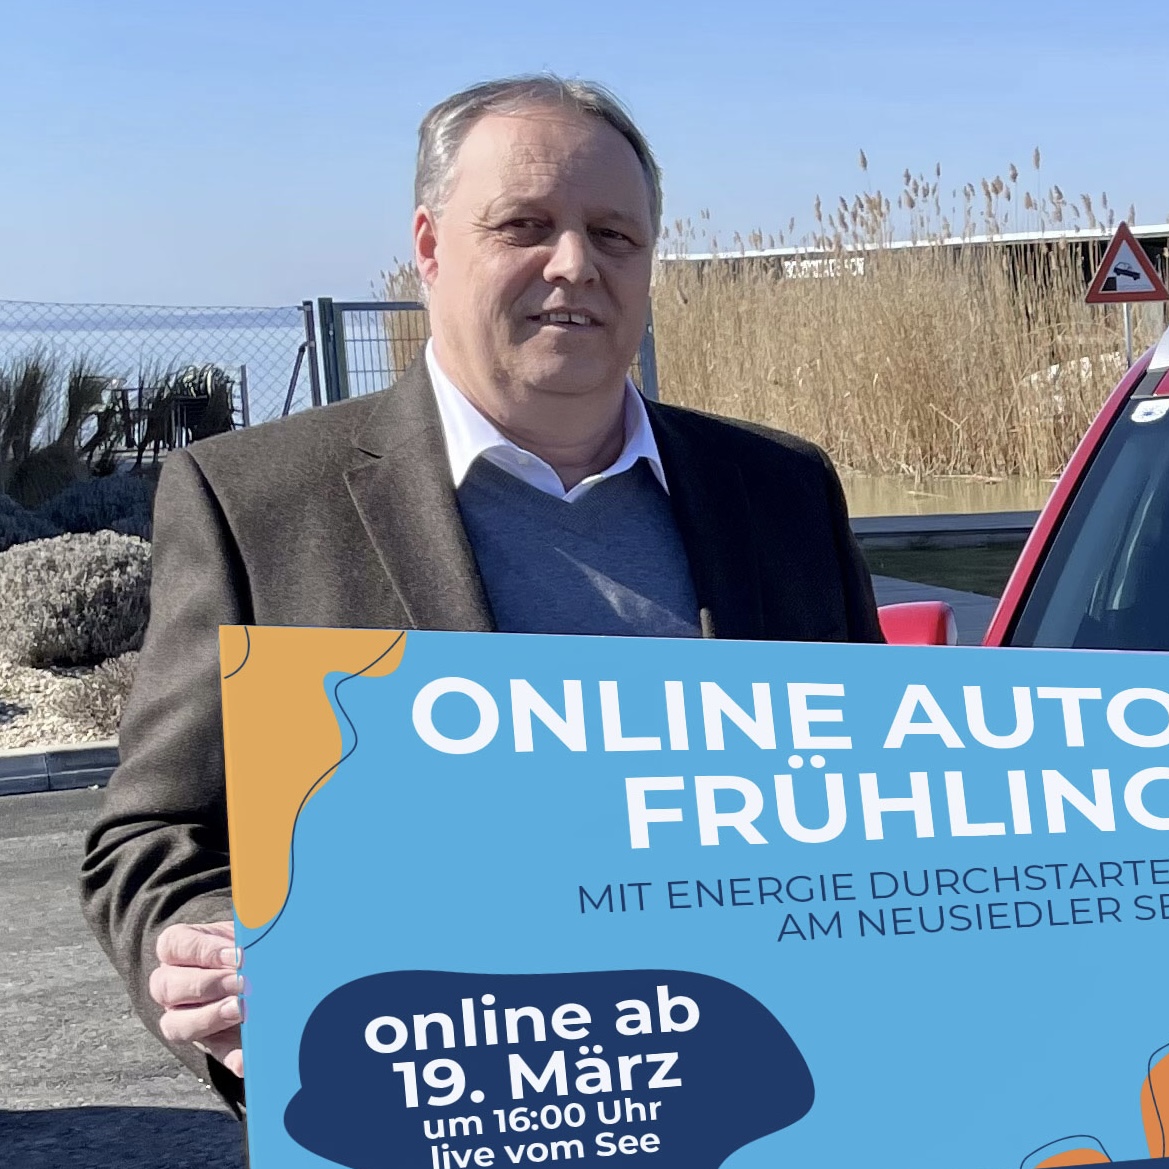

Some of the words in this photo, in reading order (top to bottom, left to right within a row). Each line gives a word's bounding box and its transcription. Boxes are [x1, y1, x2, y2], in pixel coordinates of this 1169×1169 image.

[411, 676, 853, 755] ONLINE
[578, 882, 653, 914] MIT
[667, 872, 857, 910] ENERGIE
[777, 910, 843, 943] AM
[858, 896, 1123, 938] NEUSIEDLER
[364, 993, 592, 1054] online
[615, 984, 700, 1036] ab
[392, 1058, 485, 1109] 19.
[508, 1045, 682, 1100] März
[423, 1115, 483, 1140] um
[492, 1102, 586, 1133] 16:00
[597, 1097, 662, 1125] Uhr
[503, 1139, 585, 1164] vom
[595, 1131, 661, 1157] See
